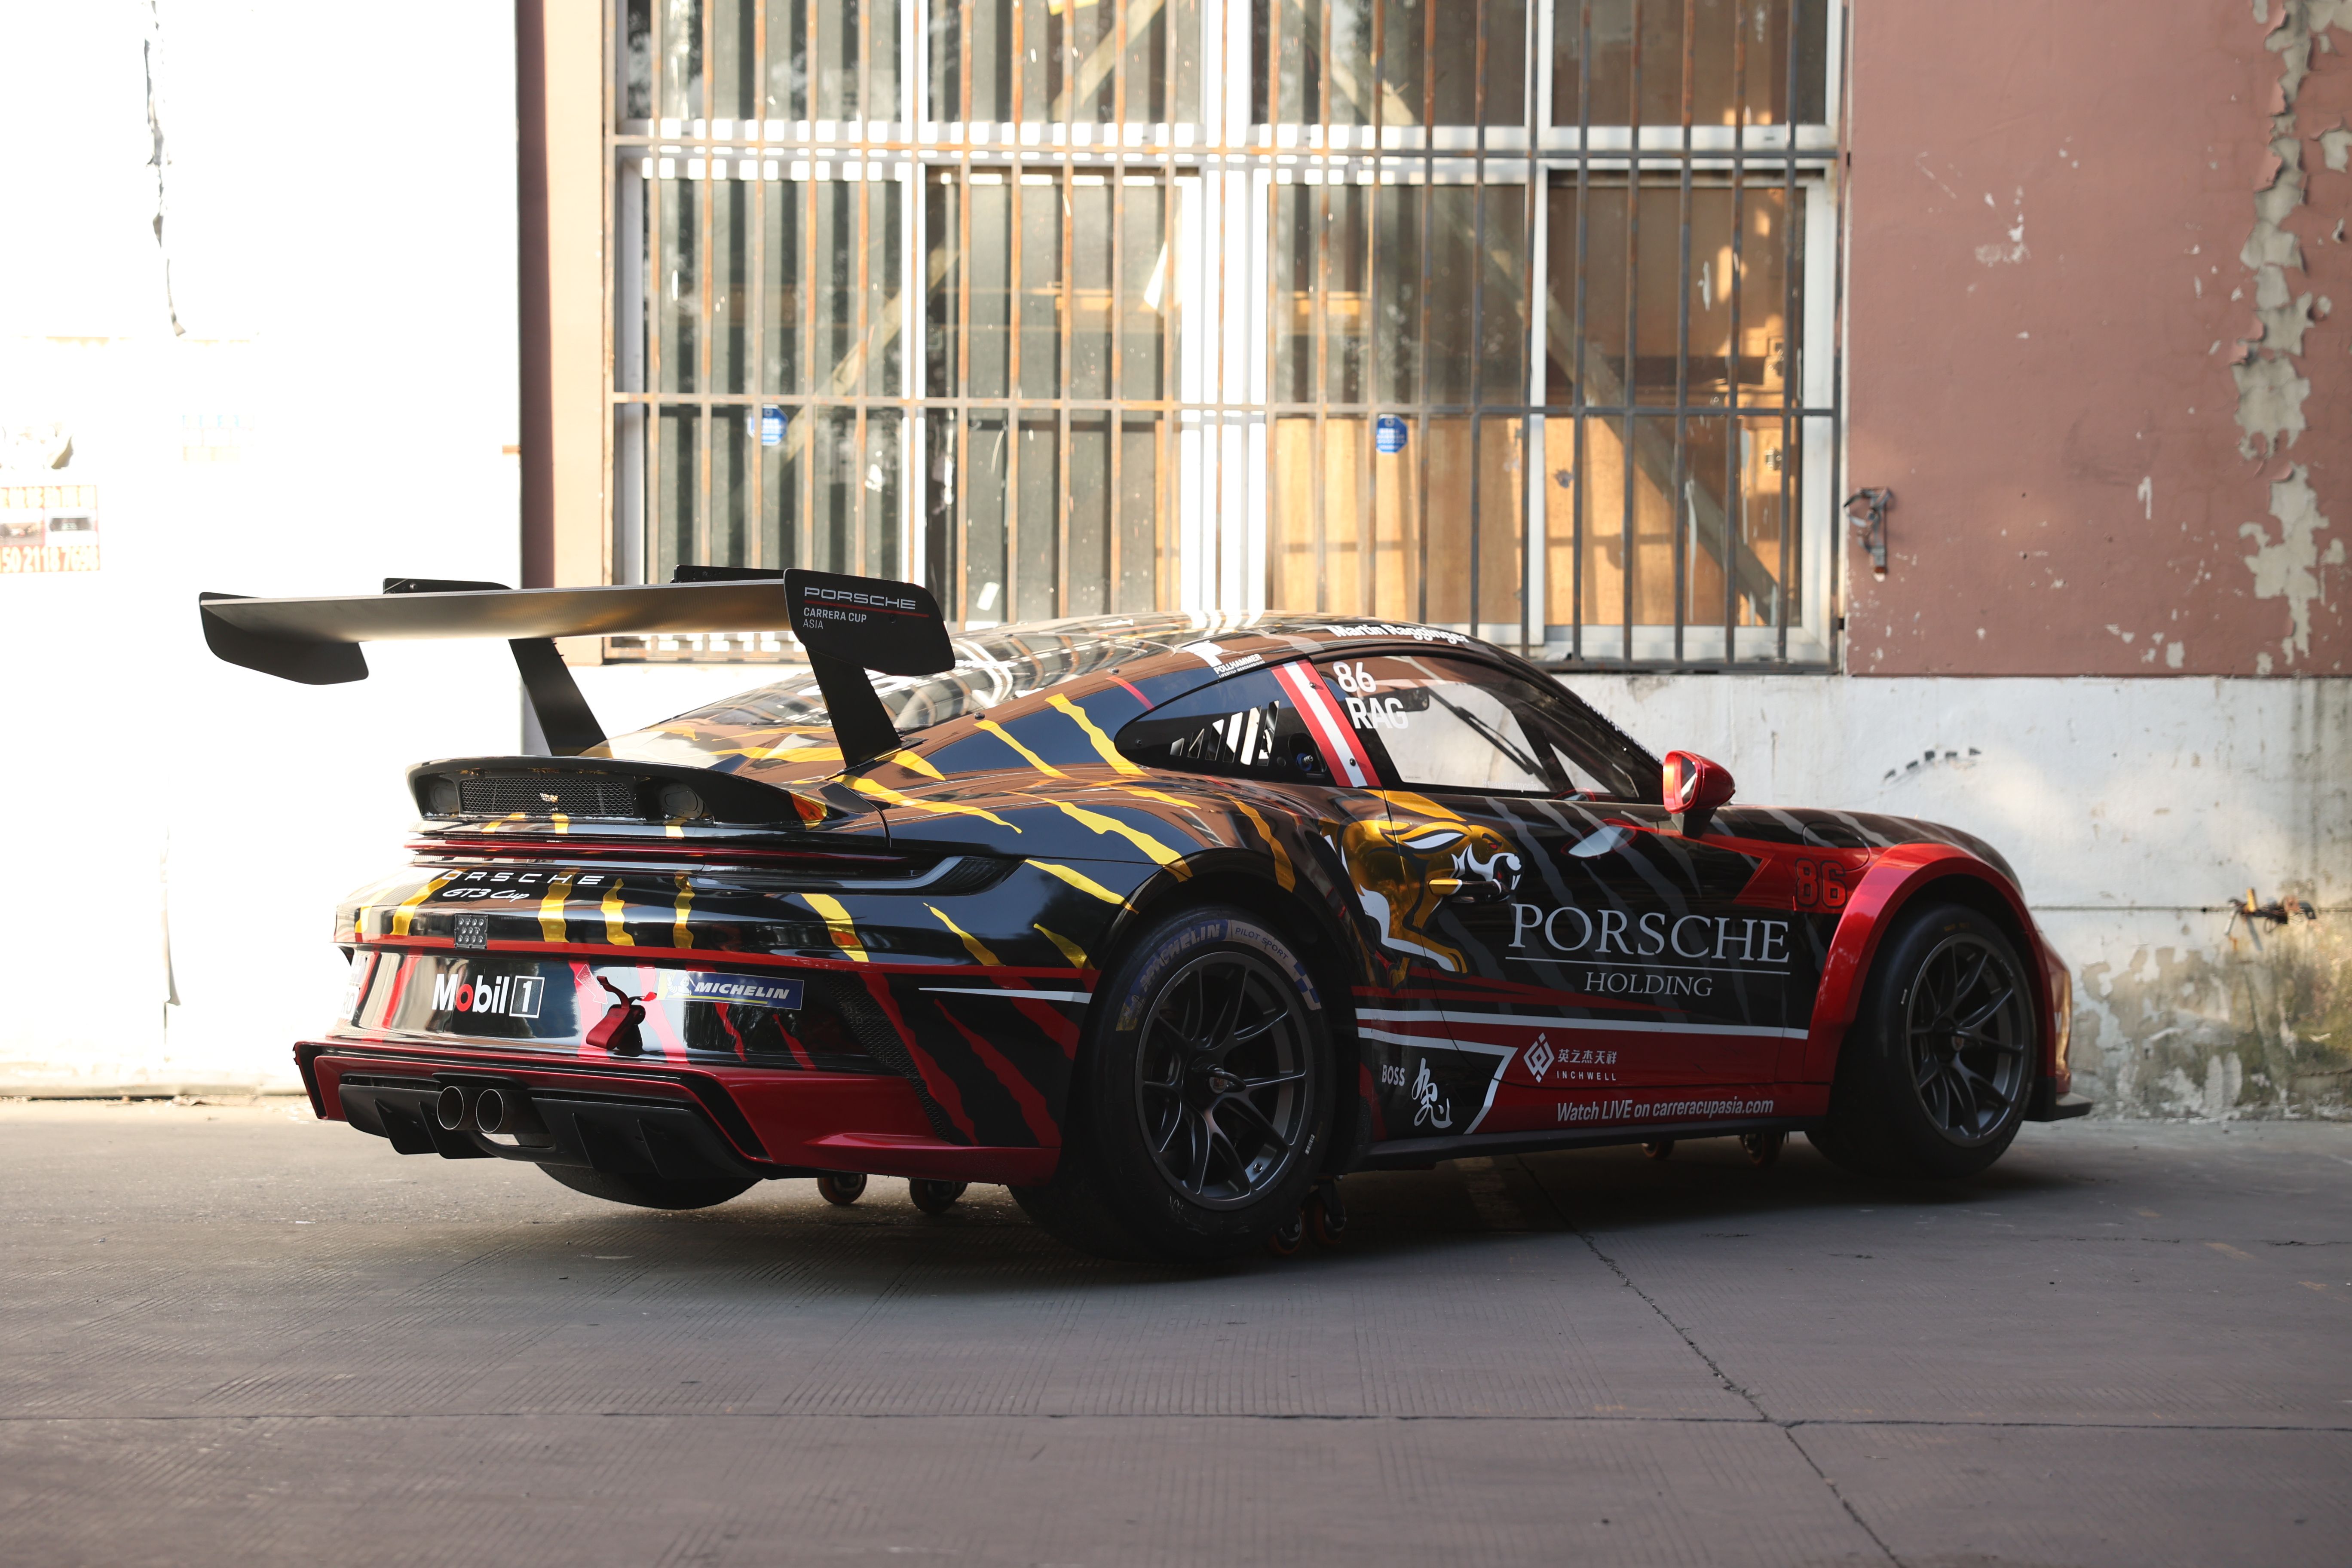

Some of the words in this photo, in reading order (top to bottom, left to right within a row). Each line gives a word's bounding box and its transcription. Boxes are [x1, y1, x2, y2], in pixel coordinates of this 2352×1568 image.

[805, 587, 916, 609] PORSCHE
[803, 607, 846, 621] CARRERA
[848, 613, 867, 623] CUP
[803, 619, 824, 629] ASIA
[1326, 625, 1383, 637] Martin
[1381, 625, 1470, 644] Ragginger
[1213, 654, 1262, 674] POLLHAMMER
[1237, 660, 1265, 671] MERCHANDISING
[1332, 662, 1376, 692] 86
[1345, 698, 1408, 729] RAG
[442, 871, 604, 885] ORSCHE
[1795, 858, 1847, 909] 86
[442, 888, 491, 897] GT3
[490, 890, 530, 902] Cup
[1235, 927, 1260, 940] PILOT
[1261, 937, 1289, 960] SPORT
[1509, 903, 1790, 963] PORSCHE
[1139, 924, 1220, 992] MICHELIN
[432, 974, 510, 1014] Mobil
[695, 982, 790, 999] MICHELIN
[1584, 972, 1712, 997] HOLDING
[1558, 1049, 1617, 1064] 英之杰天祥
[1382, 1064, 1405, 1086] BOSS
[1557, 1070, 1616, 1081] INCHWELL
[1557, 1101, 1599, 1121] Watch
[1602, 1099, 1633, 1119] LIVE
[1634, 1103, 1650, 1118] on
[1652, 1096, 1773, 1119] carreracupasia.com
